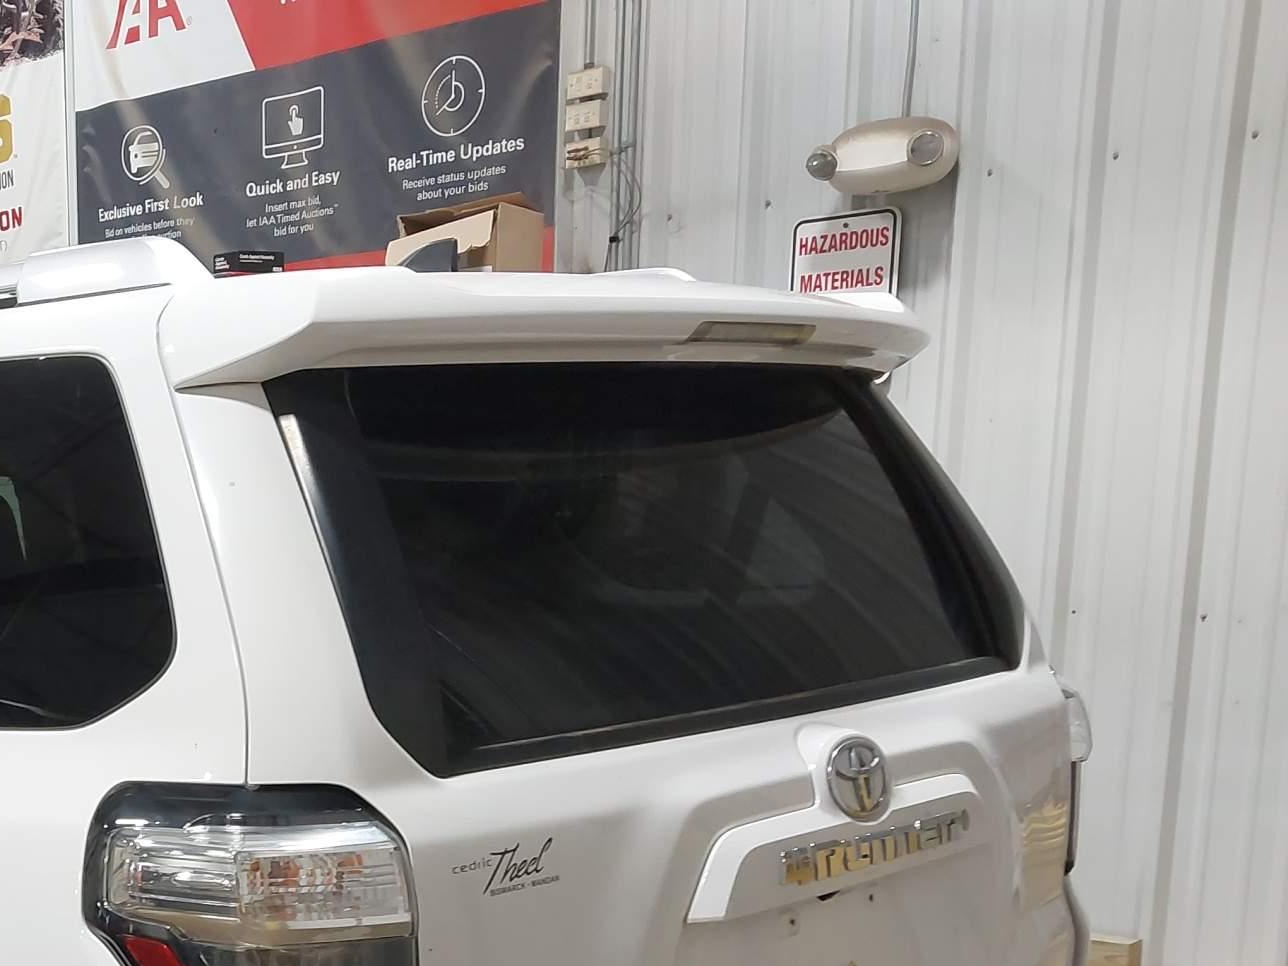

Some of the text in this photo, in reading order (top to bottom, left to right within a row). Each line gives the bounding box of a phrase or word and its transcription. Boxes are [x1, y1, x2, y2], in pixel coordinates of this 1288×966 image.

[388, 138, 525, 173] Real-Time Updates
[246, 171, 340, 197] Quick and Easy
[402, 165, 507, 190] Receive status updates
[417, 180, 489, 201] about your bids
[98, 191, 204, 222] Exclusive First Look
[265, 202, 288, 213] Insert
[290, 199, 306, 210] max
[105, 216, 195, 238] Bid on vehicles before they
[246, 218, 257, 228] let
[259, 215, 276, 226] IAA
[276, 211, 300, 224] Timed
[274, 223, 314, 237] bid for you
[798, 226, 890, 257] HAZARDOUS
[799, 265, 884, 294] MATERIALS
[451, 837, 553, 895] cedric Theel
